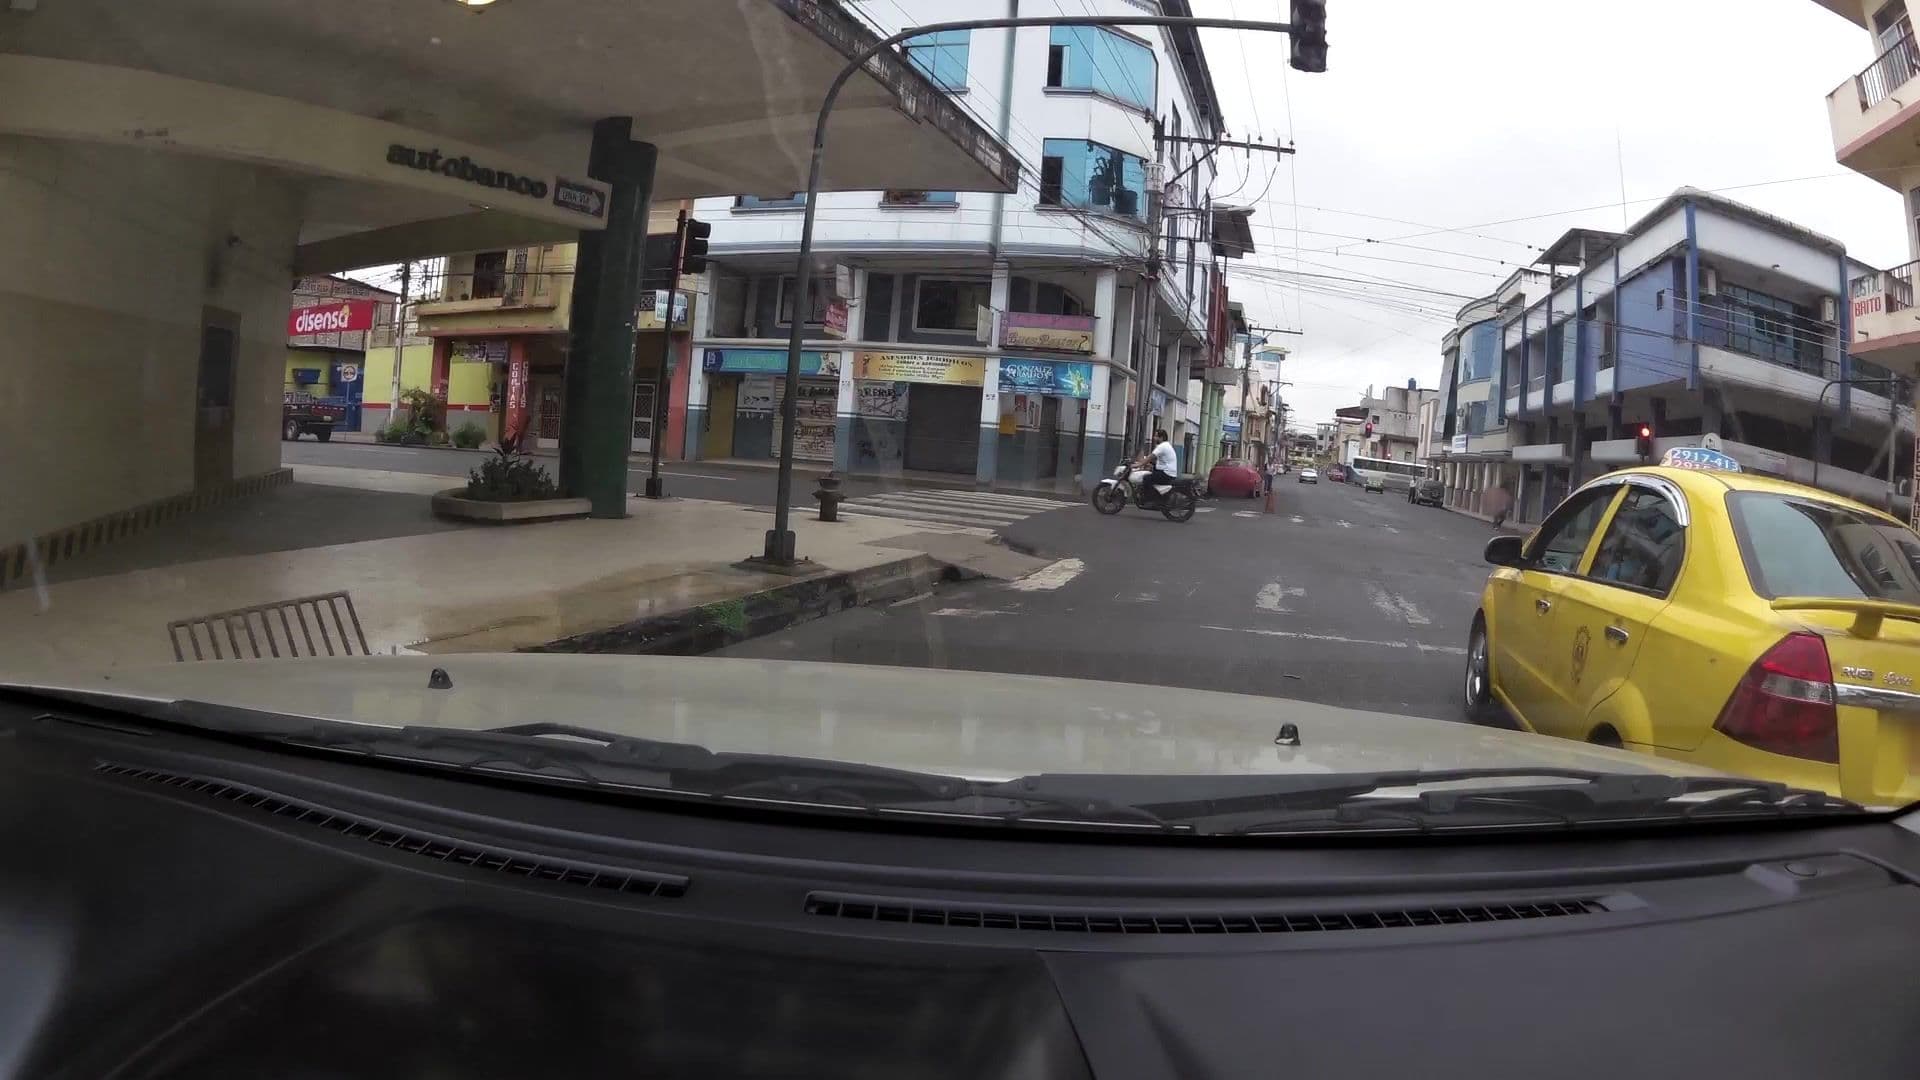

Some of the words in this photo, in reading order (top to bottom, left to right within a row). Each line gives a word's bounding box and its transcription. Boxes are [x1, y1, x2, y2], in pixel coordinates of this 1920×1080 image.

[386, 143, 548, 199] autobanco
[1854, 296, 1882, 317] BRITO
[295, 309, 349, 332] disensa
